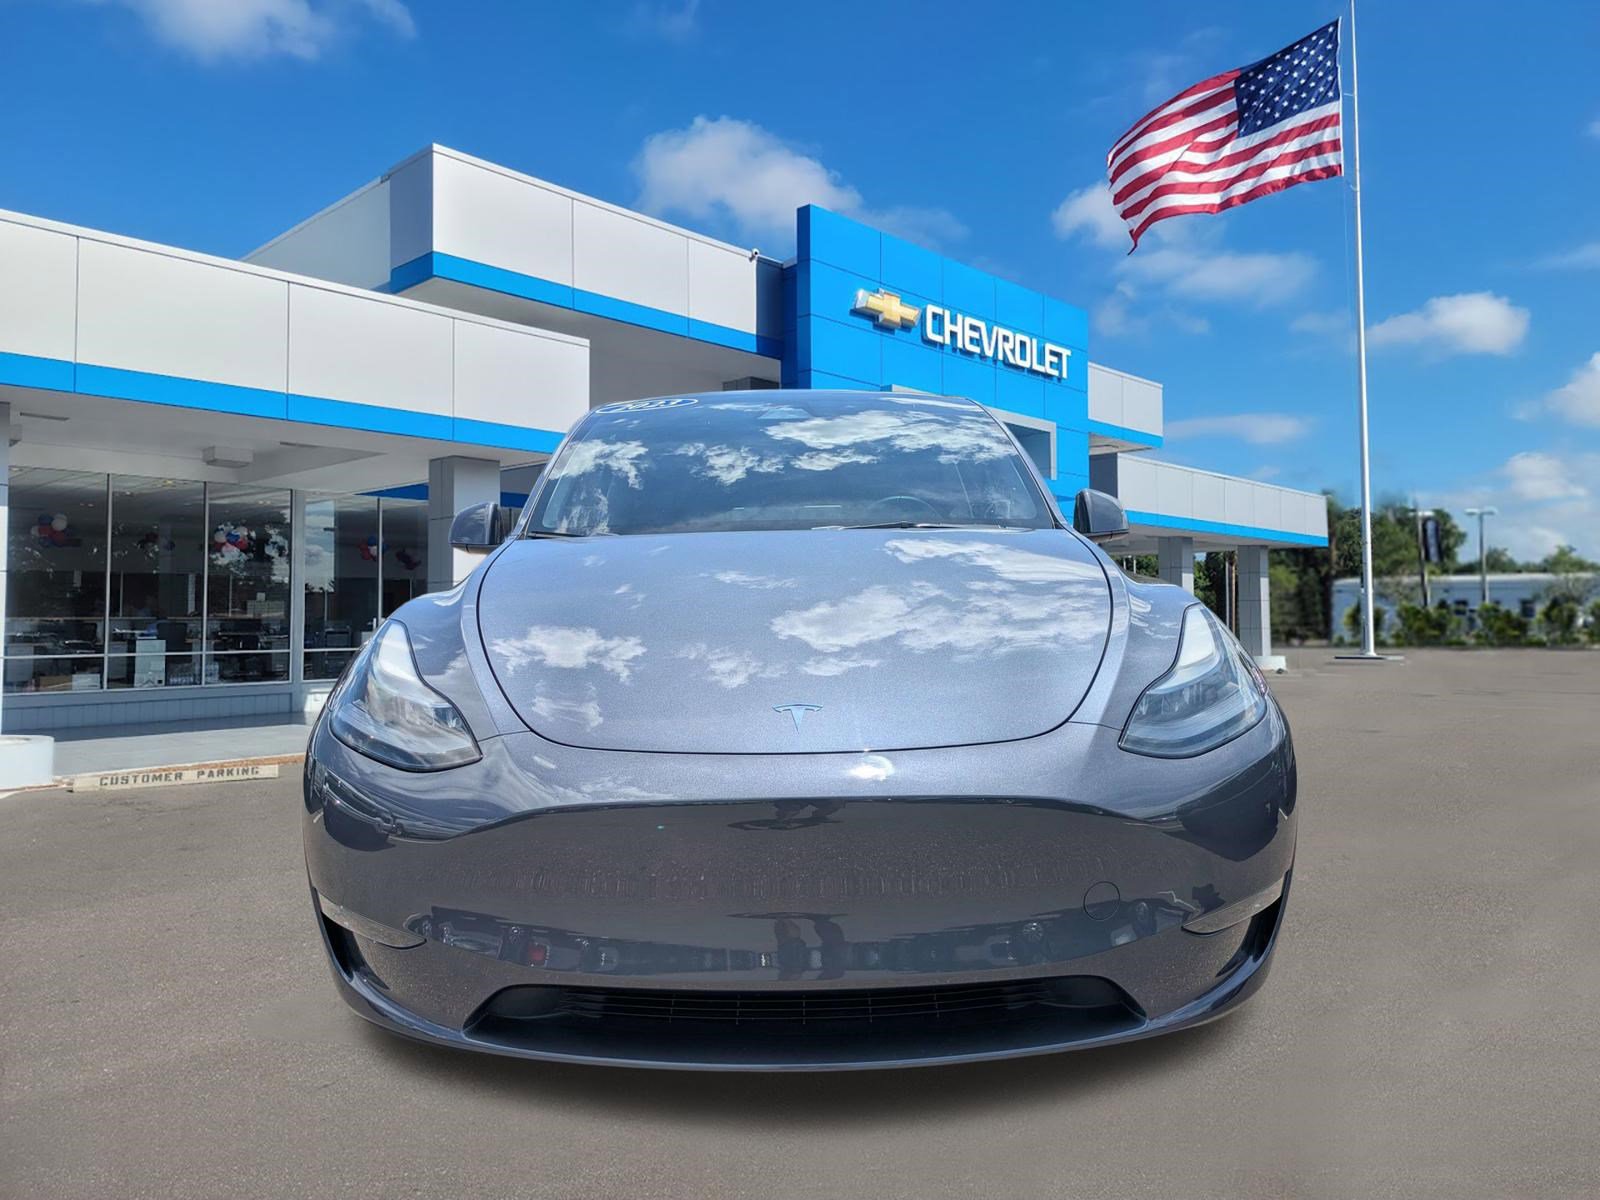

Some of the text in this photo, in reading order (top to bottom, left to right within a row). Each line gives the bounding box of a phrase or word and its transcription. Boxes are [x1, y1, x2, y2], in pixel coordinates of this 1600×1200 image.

[925, 304, 1072, 379] CHEVROLET
[99, 766, 259, 787] CUSTOMER PARKING
